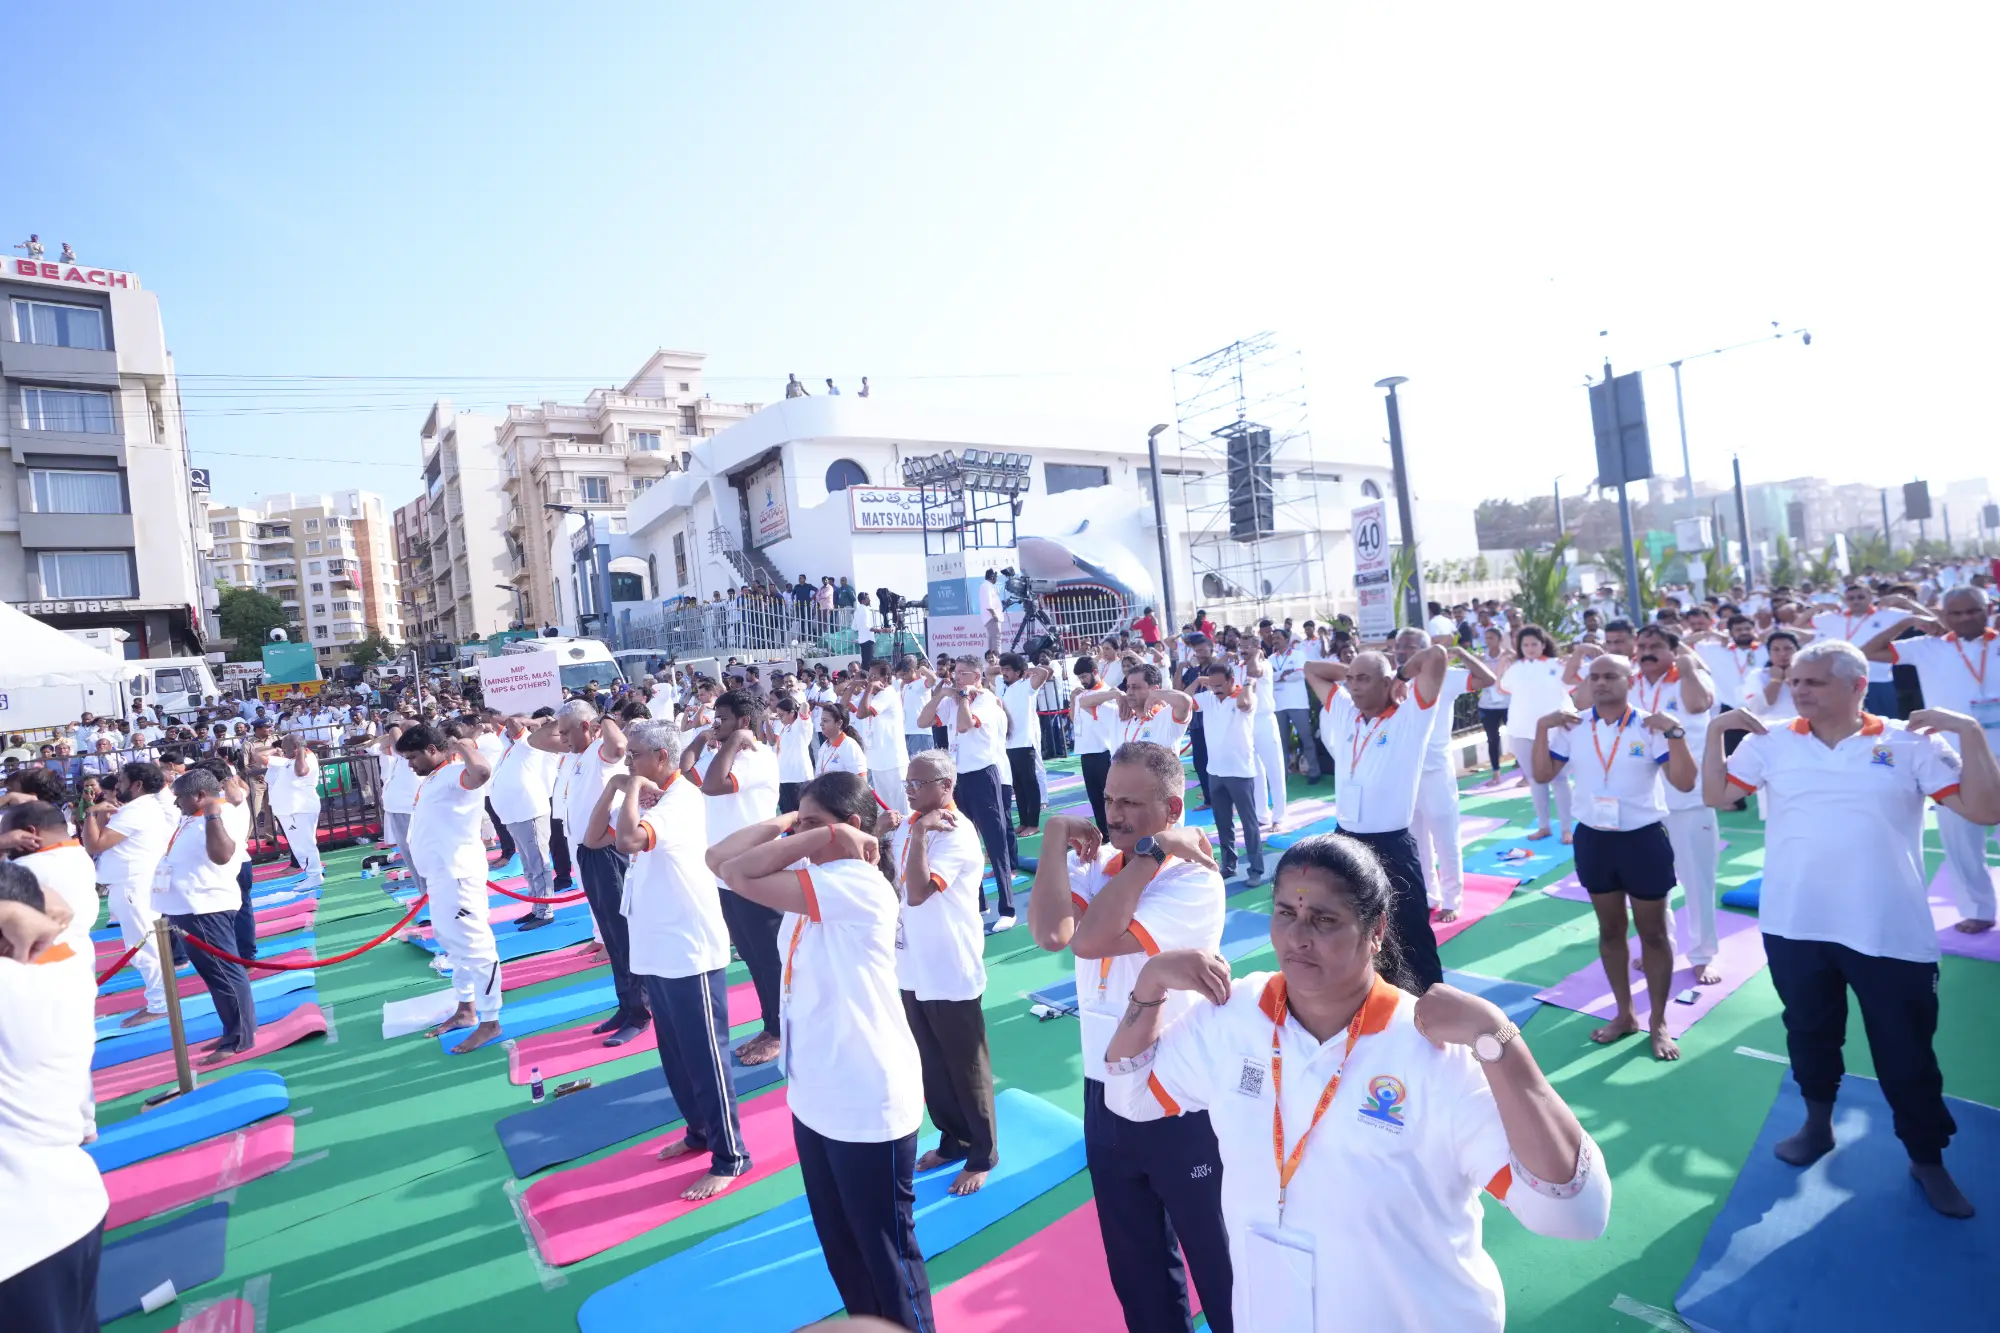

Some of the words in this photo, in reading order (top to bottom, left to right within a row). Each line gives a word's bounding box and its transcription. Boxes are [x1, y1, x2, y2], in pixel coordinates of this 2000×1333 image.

[16, 259, 128, 288] BEACH
[1358, 523, 1380, 551] 40
[957, 640, 984, 648] OTHERS)
[484, 675, 531, 687] (MINISTERS,
[531, 671, 555, 680] MLAS,
[490, 686, 508, 694] MPS
[517, 679, 551, 690] OTHERS)
[1190, 1166, 1212, 1179] NAVY
[1193, 1163, 1207, 1173] IDY
